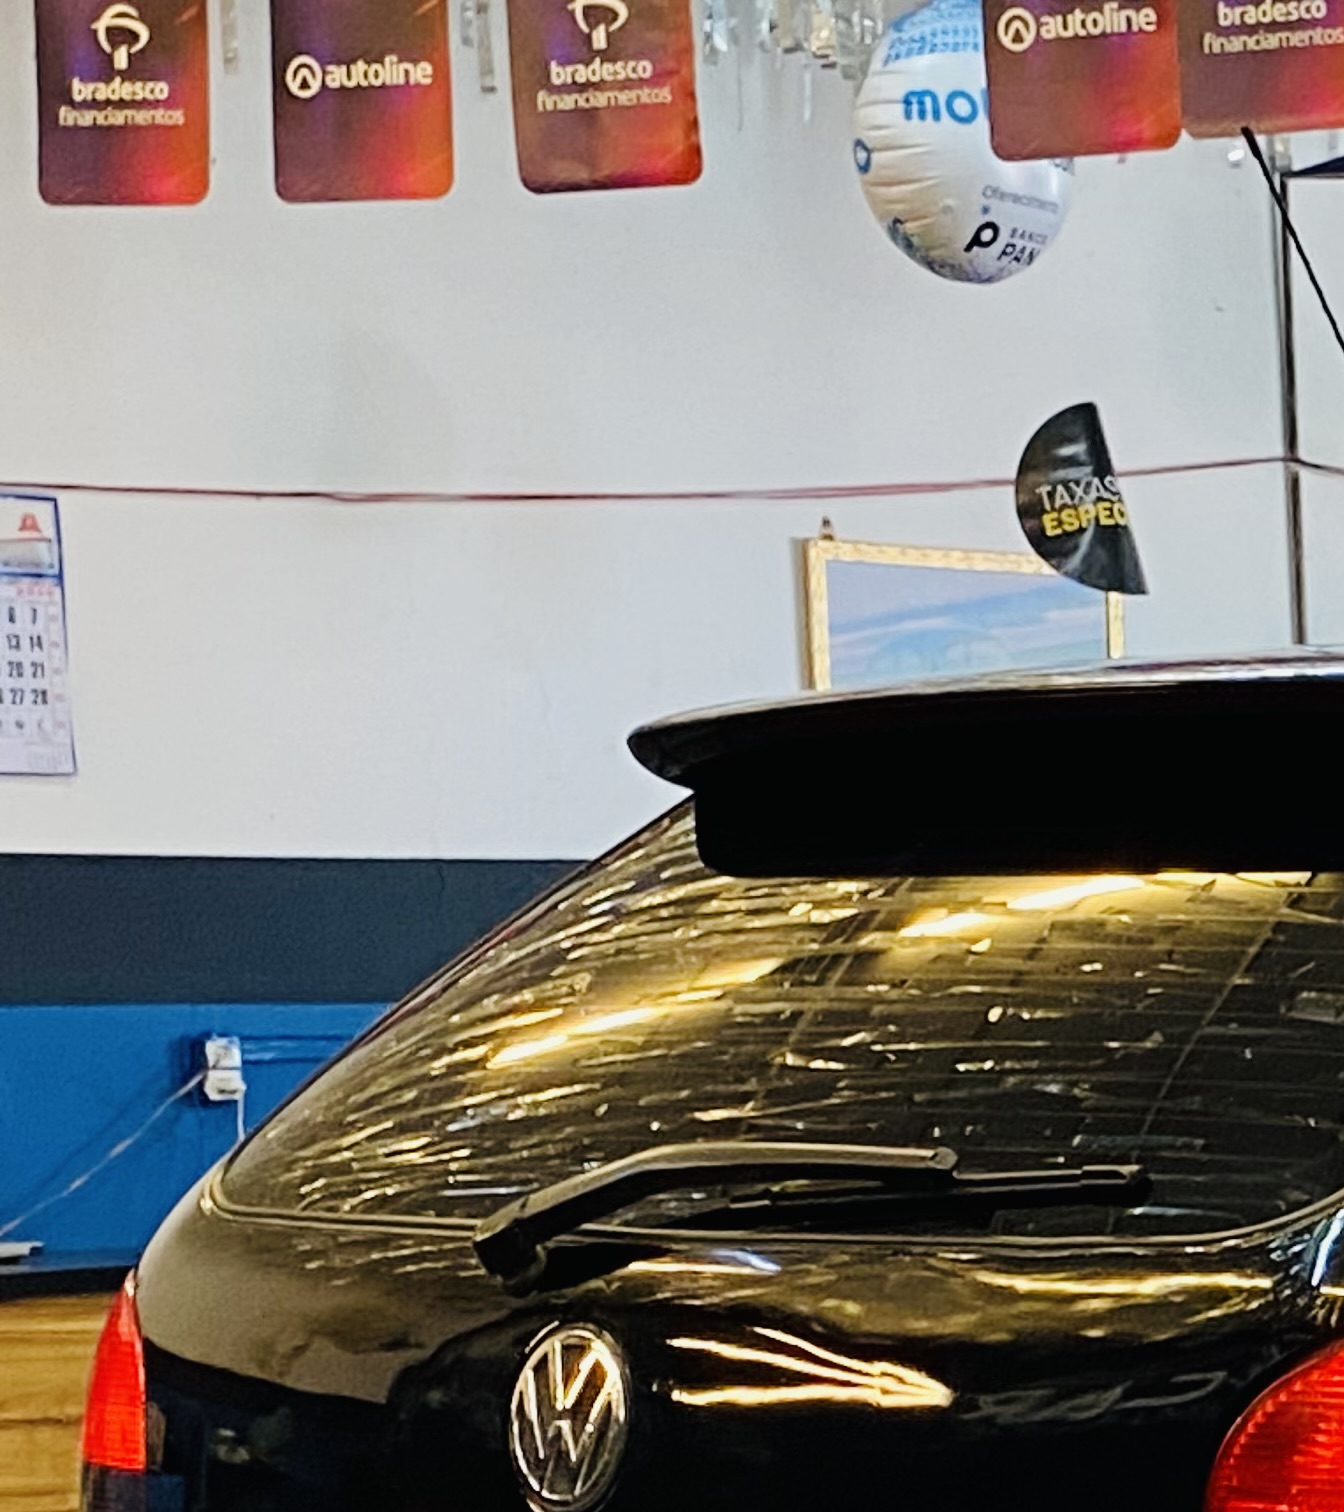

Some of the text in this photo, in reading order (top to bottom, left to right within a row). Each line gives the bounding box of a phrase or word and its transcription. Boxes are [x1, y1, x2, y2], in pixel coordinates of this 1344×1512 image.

[1038, 4, 1158, 41] autoline
[1216, 0, 1328, 27] bradesco
[324, 54, 433, 89] autoline
[549, 57, 654, 86] bradesco
[72, 76, 169, 102] bradesco
[536, 84, 673, 113] financiamentos
[58, 105, 185, 127] financiamentos
[903, 89, 990, 124] mo
